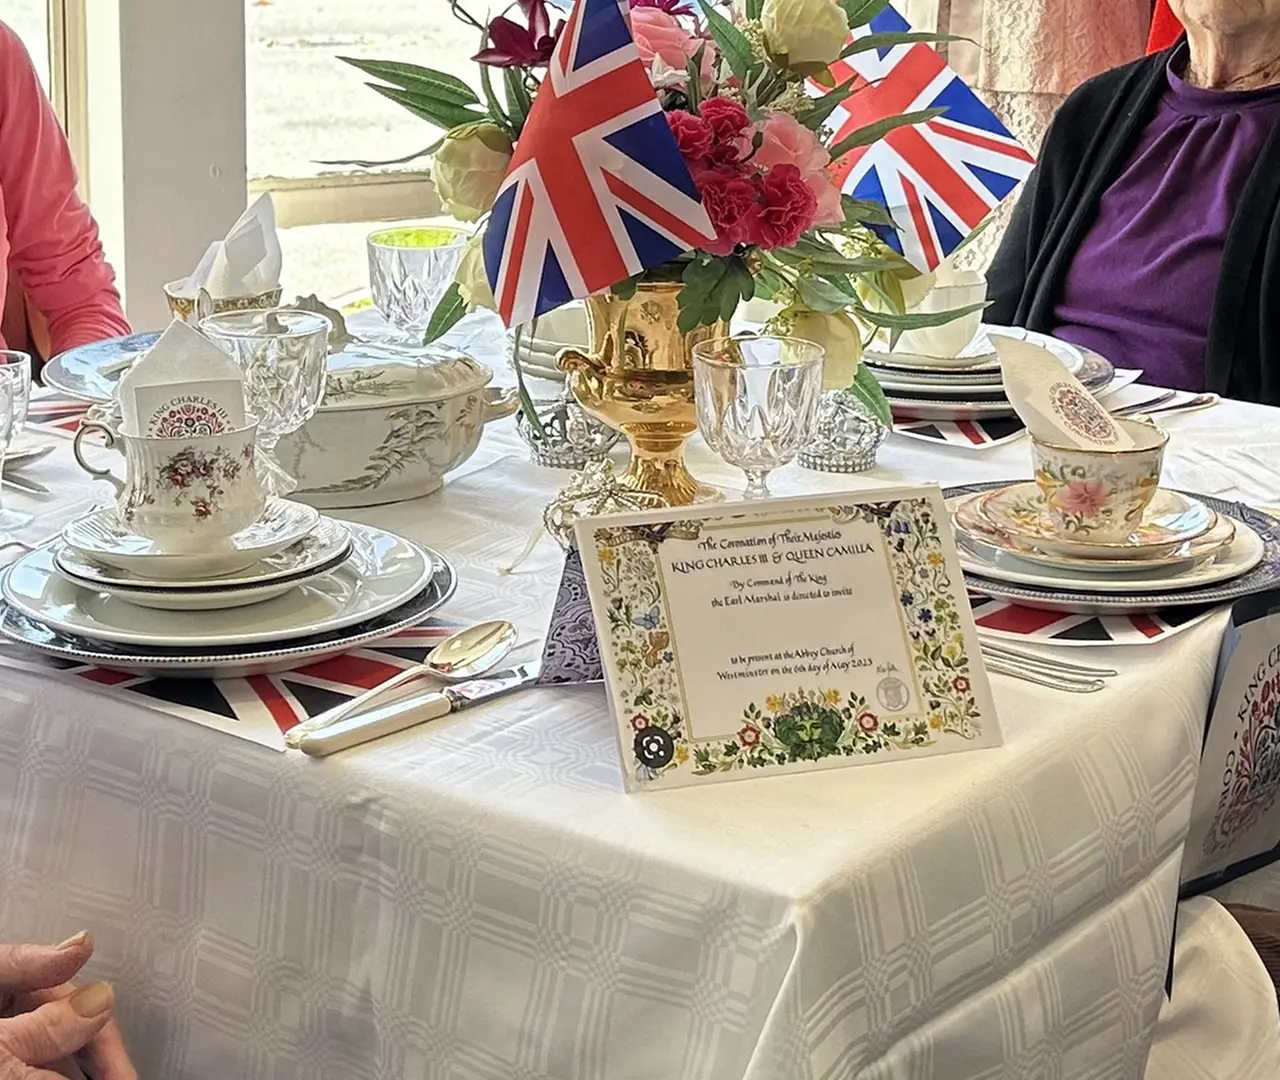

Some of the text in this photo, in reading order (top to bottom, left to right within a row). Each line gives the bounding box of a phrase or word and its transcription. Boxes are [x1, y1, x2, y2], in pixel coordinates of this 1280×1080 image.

[149, 395, 229, 425] KING CHARLES III
[698, 536, 717, 551] The
[719, 537, 767, 550] Coronation
[768, 532, 776, 548] of
[777, 528, 803, 544] Their
[671, 560, 705, 574] KING
[705, 554, 757, 569] CHARLES
[759, 553, 768, 564] III
[785, 548, 825, 564] QUEEN
[826, 543, 875, 558] CAMILLA
[730, 580, 745, 591] By
[746, 576, 785, 588] Command
[785, 571, 792, 587] of
[711, 597, 724, 608] the
[724, 595, 743, 607] Earl
[744, 592, 781, 605] Marshal
[791, 590, 822, 601] directed
[820, 645, 847, 657] Church
[847, 641, 855, 658] of
[716, 668, 768, 681] Westminster
[781, 665, 793, 675] the
[807, 663, 821, 676] day
[822, 659, 830, 675] of
[830, 661, 850, 674] May
[851, 658, 873, 669] 2023
[1236, 662, 1267, 722] KING
